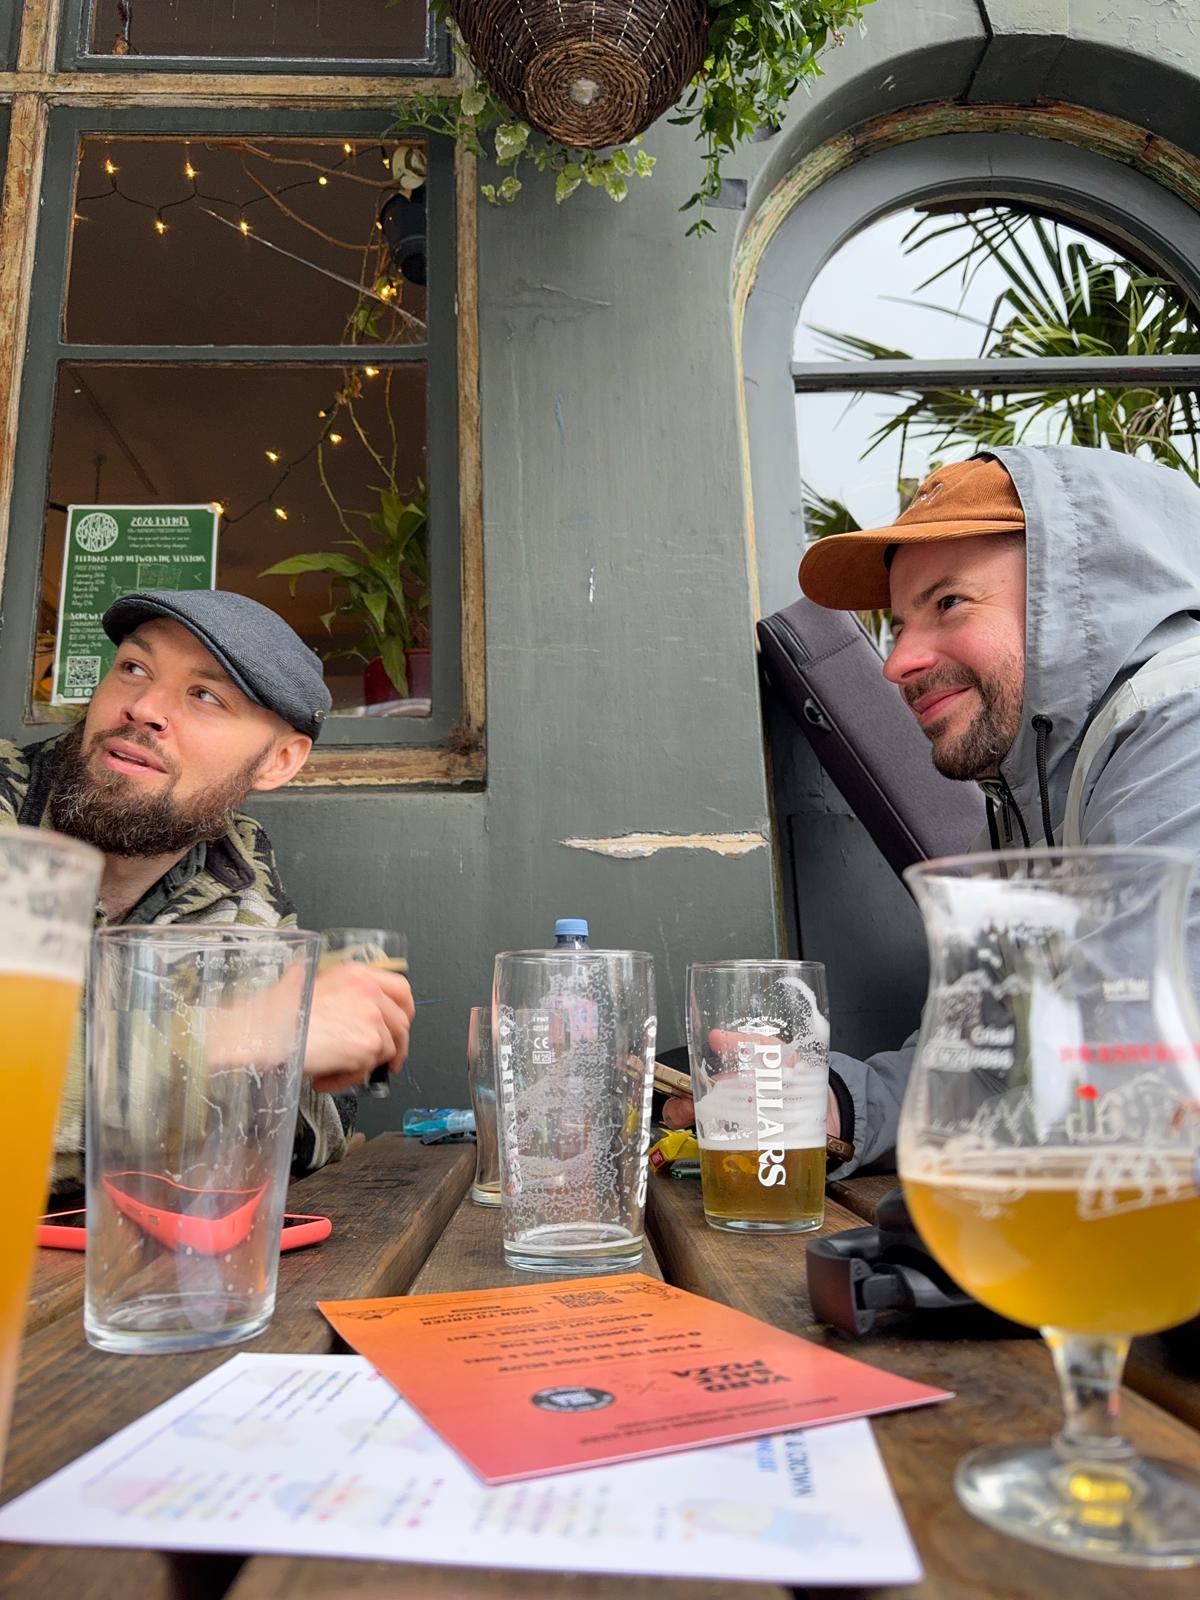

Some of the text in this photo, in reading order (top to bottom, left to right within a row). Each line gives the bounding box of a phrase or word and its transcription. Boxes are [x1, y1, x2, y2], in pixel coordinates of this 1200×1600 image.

[156, 516, 190, 526] EVENTS
[74, 554, 206, 563] FEEDBACK AND NETWORKING SESSIONS
[754, 1044, 787, 1188] PILLARS
[477, 1312, 496, 1320] TO
[501, 1308, 539, 1318] SCAN
[420, 1316, 474, 1326] ORDER
[598, 1314, 638, 1324] CHECK
[500, 1326, 536, 1336] BACK
[541, 1323, 562, 1332] SIT
[446, 1334, 482, 1342] WAIT
[584, 1330, 628, 1339] ORDER
[655, 1332, 686, 1342] PICK
[499, 1341, 528, 1349] PUB
[532, 1338, 556, 1346] THE
[616, 1338, 648, 1346] YOUR
[522, 1348, 554, 1358] DIPS
[620, 1350, 642, 1358] THE
[648, 1346, 686, 1355] SCAN
[553, 1356, 590, 1366] CODE
[498, 1362, 548, 1372] BELOW
[670, 1359, 764, 1378] PIZZA
[693, 1369, 773, 1386] SALE
[703, 1374, 791, 1393] YARD
